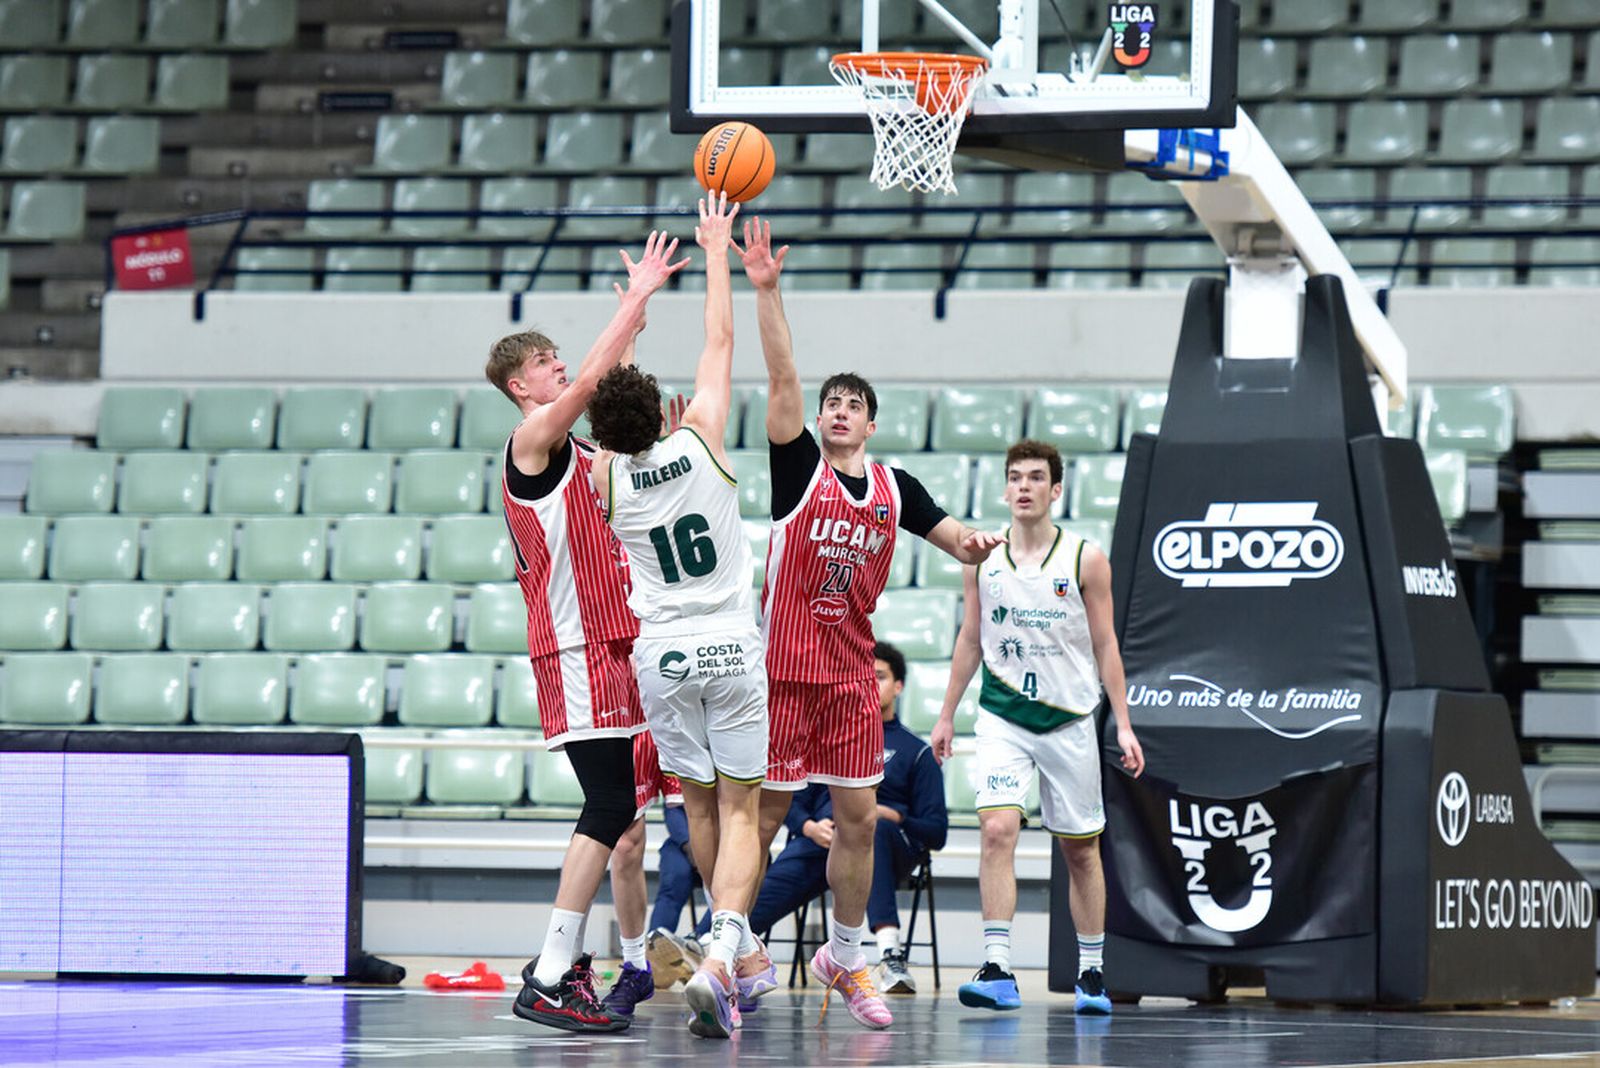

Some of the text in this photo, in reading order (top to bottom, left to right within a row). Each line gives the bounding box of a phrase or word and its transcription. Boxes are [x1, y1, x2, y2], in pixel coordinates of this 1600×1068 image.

[1111, 5, 1155, 23] LIGA
[708, 128, 737, 176] Wilson
[630, 455, 693, 490] VALERO
[648, 513, 718, 583] 16
[809, 517, 887, 555] UCAM
[817, 545, 867, 567] MURCIA
[820, 561, 853, 594] 20
[814, 603, 846, 617] Juver
[1011, 607, 1067, 620] Fundación
[1012, 618, 1051, 631] Unicaja
[696, 644, 744, 658] COSTA
[697, 656, 745, 669] DEL SOL
[1022, 672, 1038, 698] 4
[1126, 685, 1362, 713] Uno más de la familia
[1169, 799, 1275, 839] LIGA
[1475, 794, 1514, 824] LABASA
[1435, 878, 1593, 929] LET'S GO BEYOND
